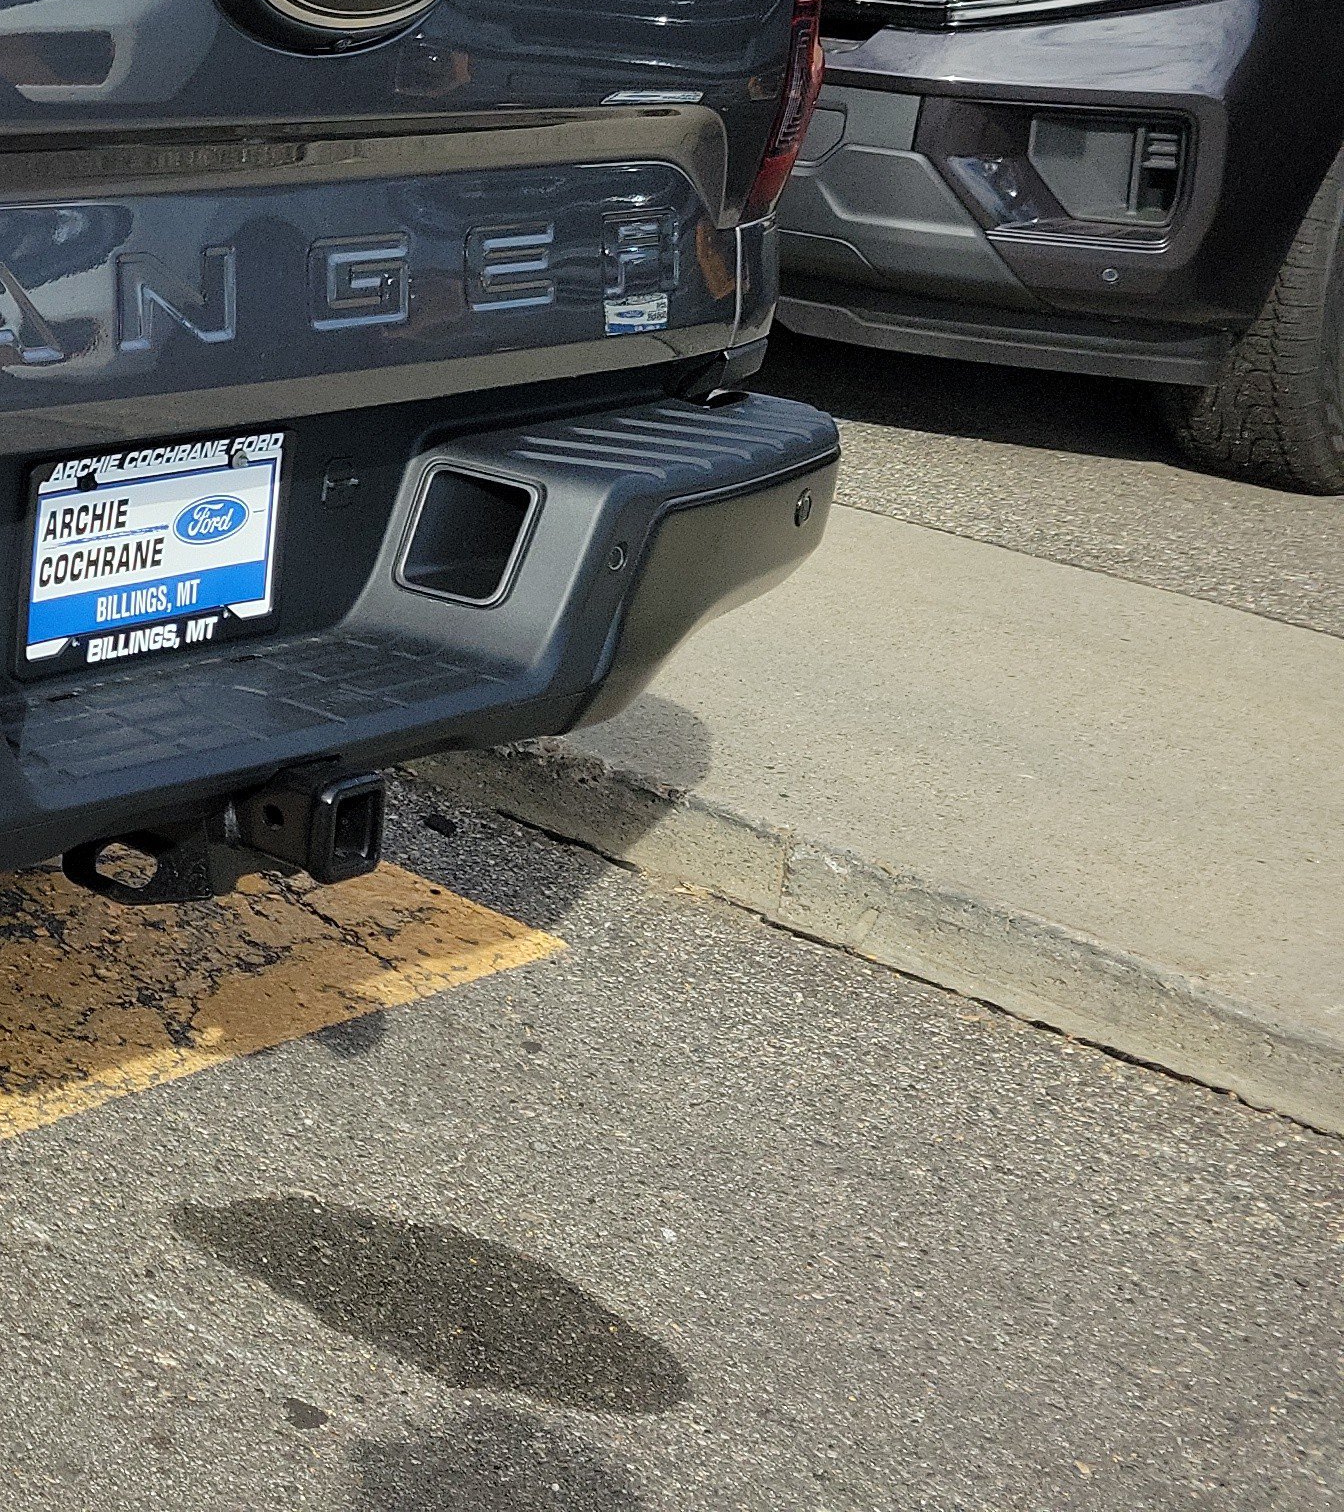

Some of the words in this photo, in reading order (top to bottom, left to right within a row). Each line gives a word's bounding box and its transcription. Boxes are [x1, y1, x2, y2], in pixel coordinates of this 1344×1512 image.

[48, 453, 122, 482] ARCHIE
[122, 439, 228, 471] COCHRANE
[231, 432, 284, 457] FORD
[42, 498, 130, 542] ARCHIE
[188, 502, 234, 536] Ford
[39, 537, 165, 588] COCHRANE
[95, 583, 173, 623] BILLINGS,
[176, 578, 201, 607] MT
[86, 623, 181, 663] BILLINGS,
[185, 616, 219, 642] MT
